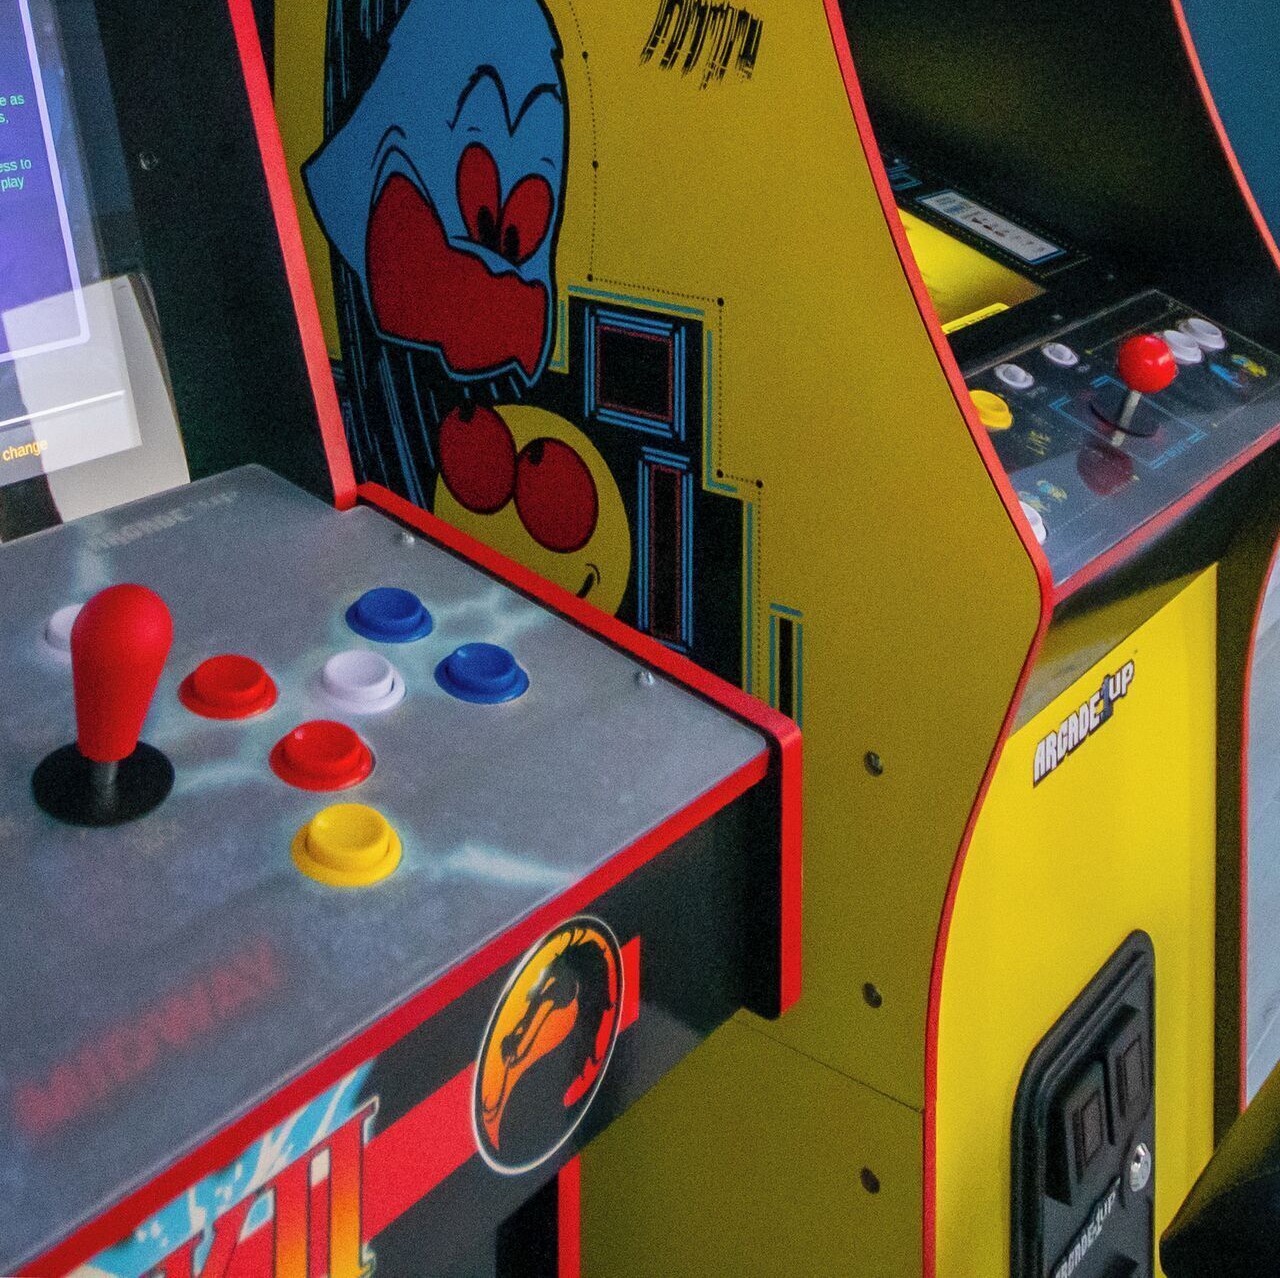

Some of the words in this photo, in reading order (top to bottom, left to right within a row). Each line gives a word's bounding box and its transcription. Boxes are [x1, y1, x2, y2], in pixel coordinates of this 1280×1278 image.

[10, 94, 25, 105] as
[20, 158, 32, 171] to
[0, 175, 25, 191] play
[2, 438, 48, 465] change
